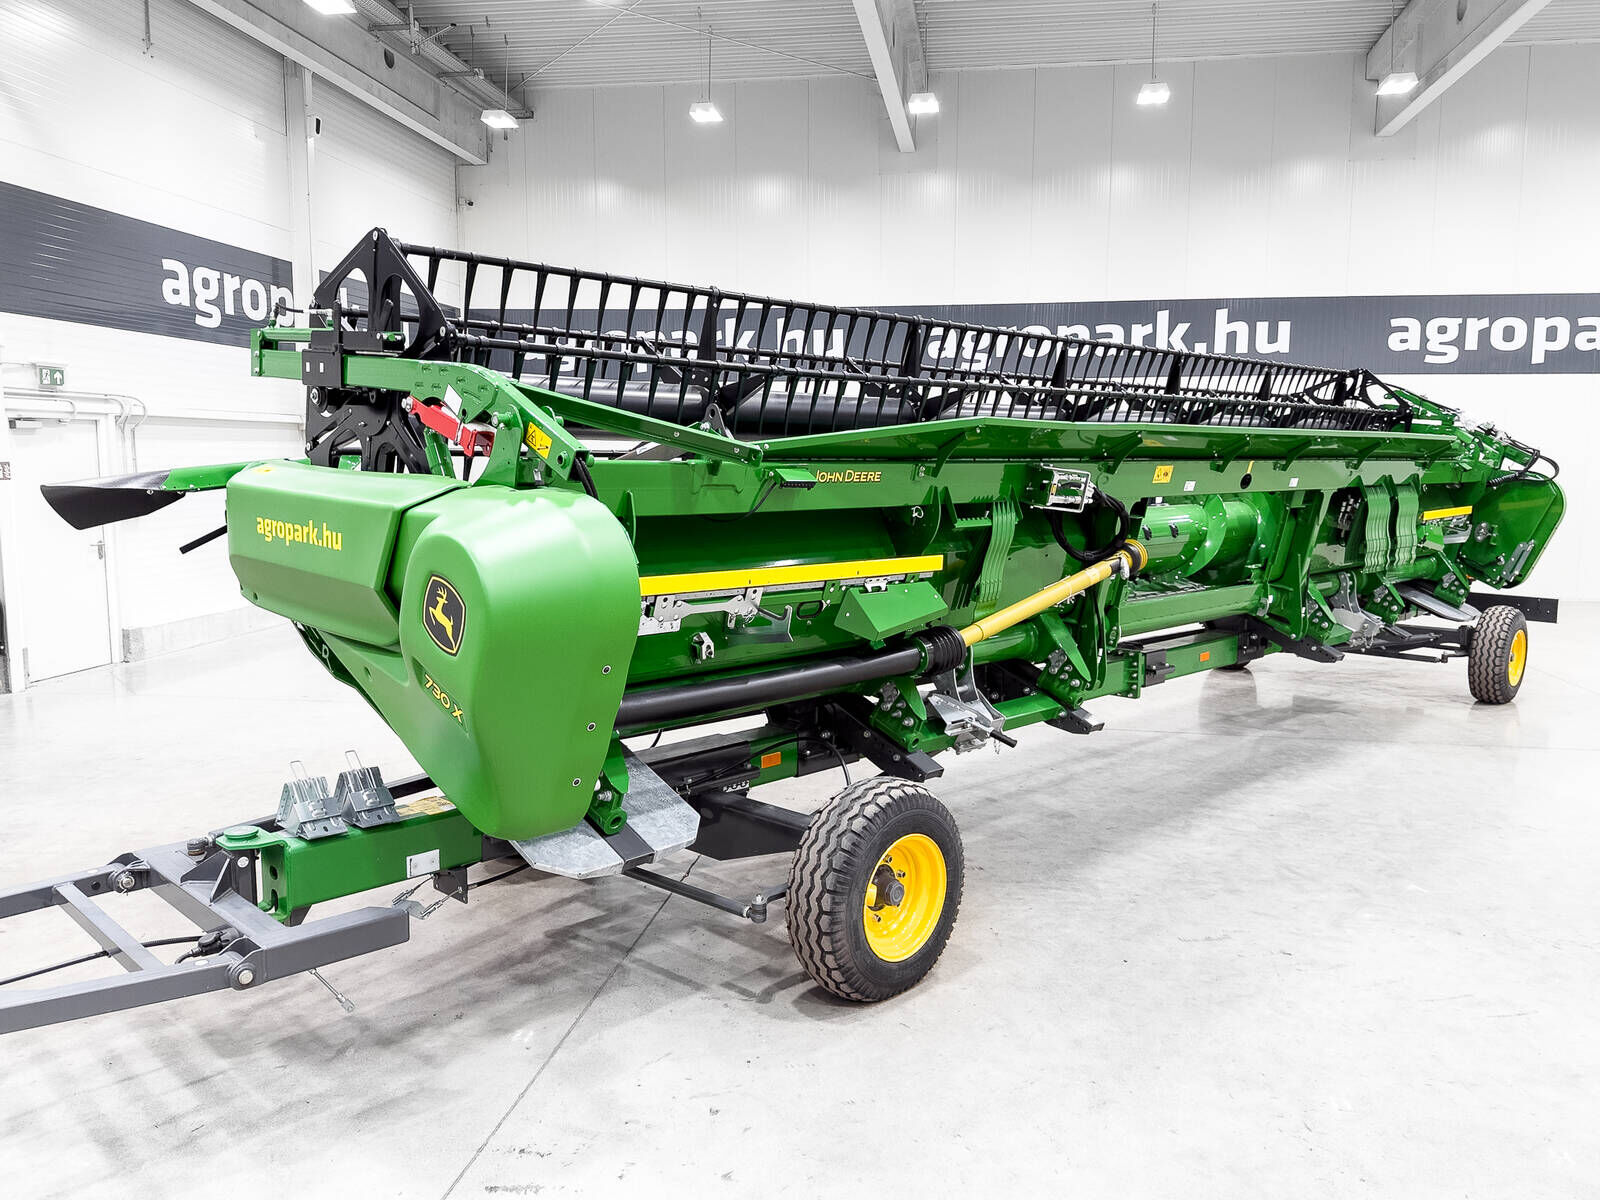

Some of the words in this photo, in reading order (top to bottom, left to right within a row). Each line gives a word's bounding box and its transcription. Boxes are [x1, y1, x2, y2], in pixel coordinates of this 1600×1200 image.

[926, 308, 1291, 373] agropark.hu
[845, 469, 882, 482] DEERE
[256, 516, 342, 552] agropark.hu
[424, 673, 451, 709] 730
[451, 703, 464, 724] X
